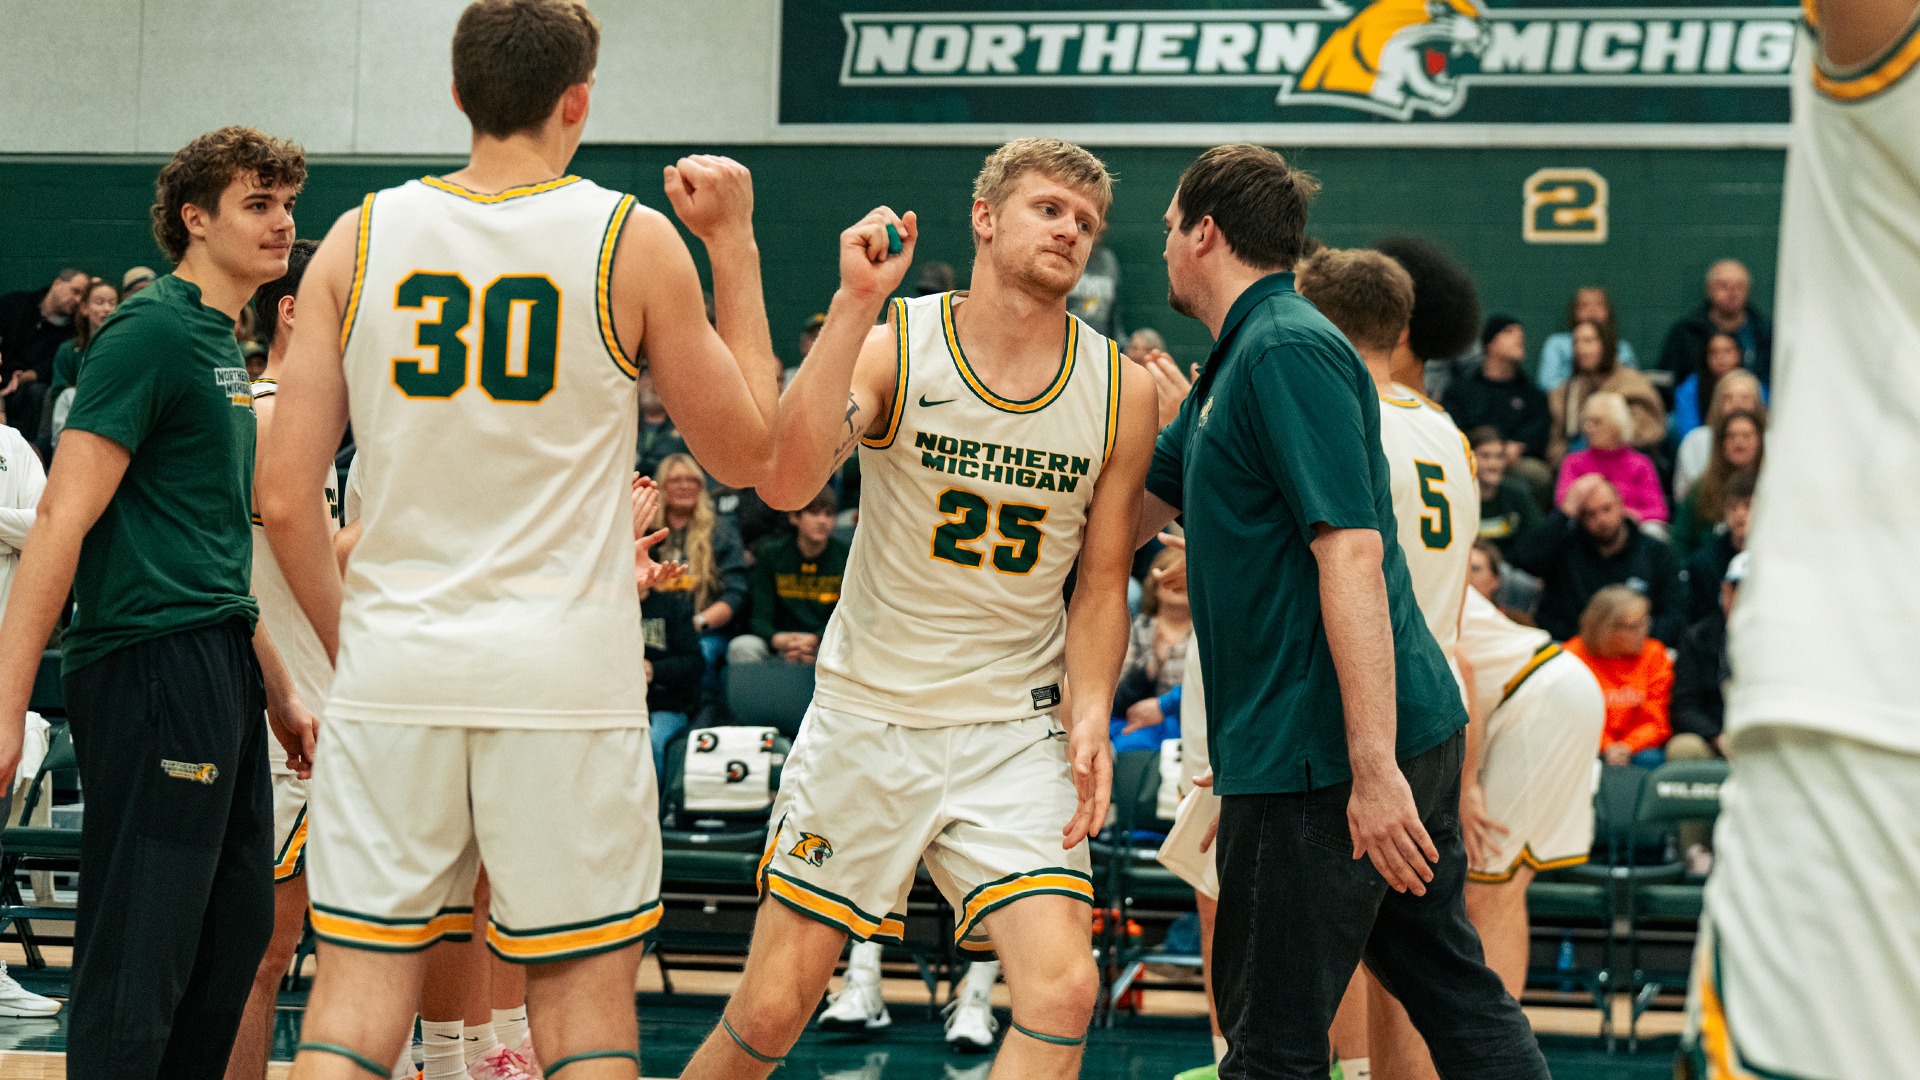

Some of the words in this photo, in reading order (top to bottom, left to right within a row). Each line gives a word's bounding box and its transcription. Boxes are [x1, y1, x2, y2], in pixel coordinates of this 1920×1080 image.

[854, 23, 1320, 74] NORTHERN
[1481, 21, 1795, 74] MICHIG
[1523, 167, 1608, 243] 2
[390, 269, 562, 405] 30
[914, 430, 1091, 476] NORTHERN
[921, 450, 1079, 493] MICHIGAN
[929, 486, 1050, 576] 25
[1413, 457, 1454, 551] 5
